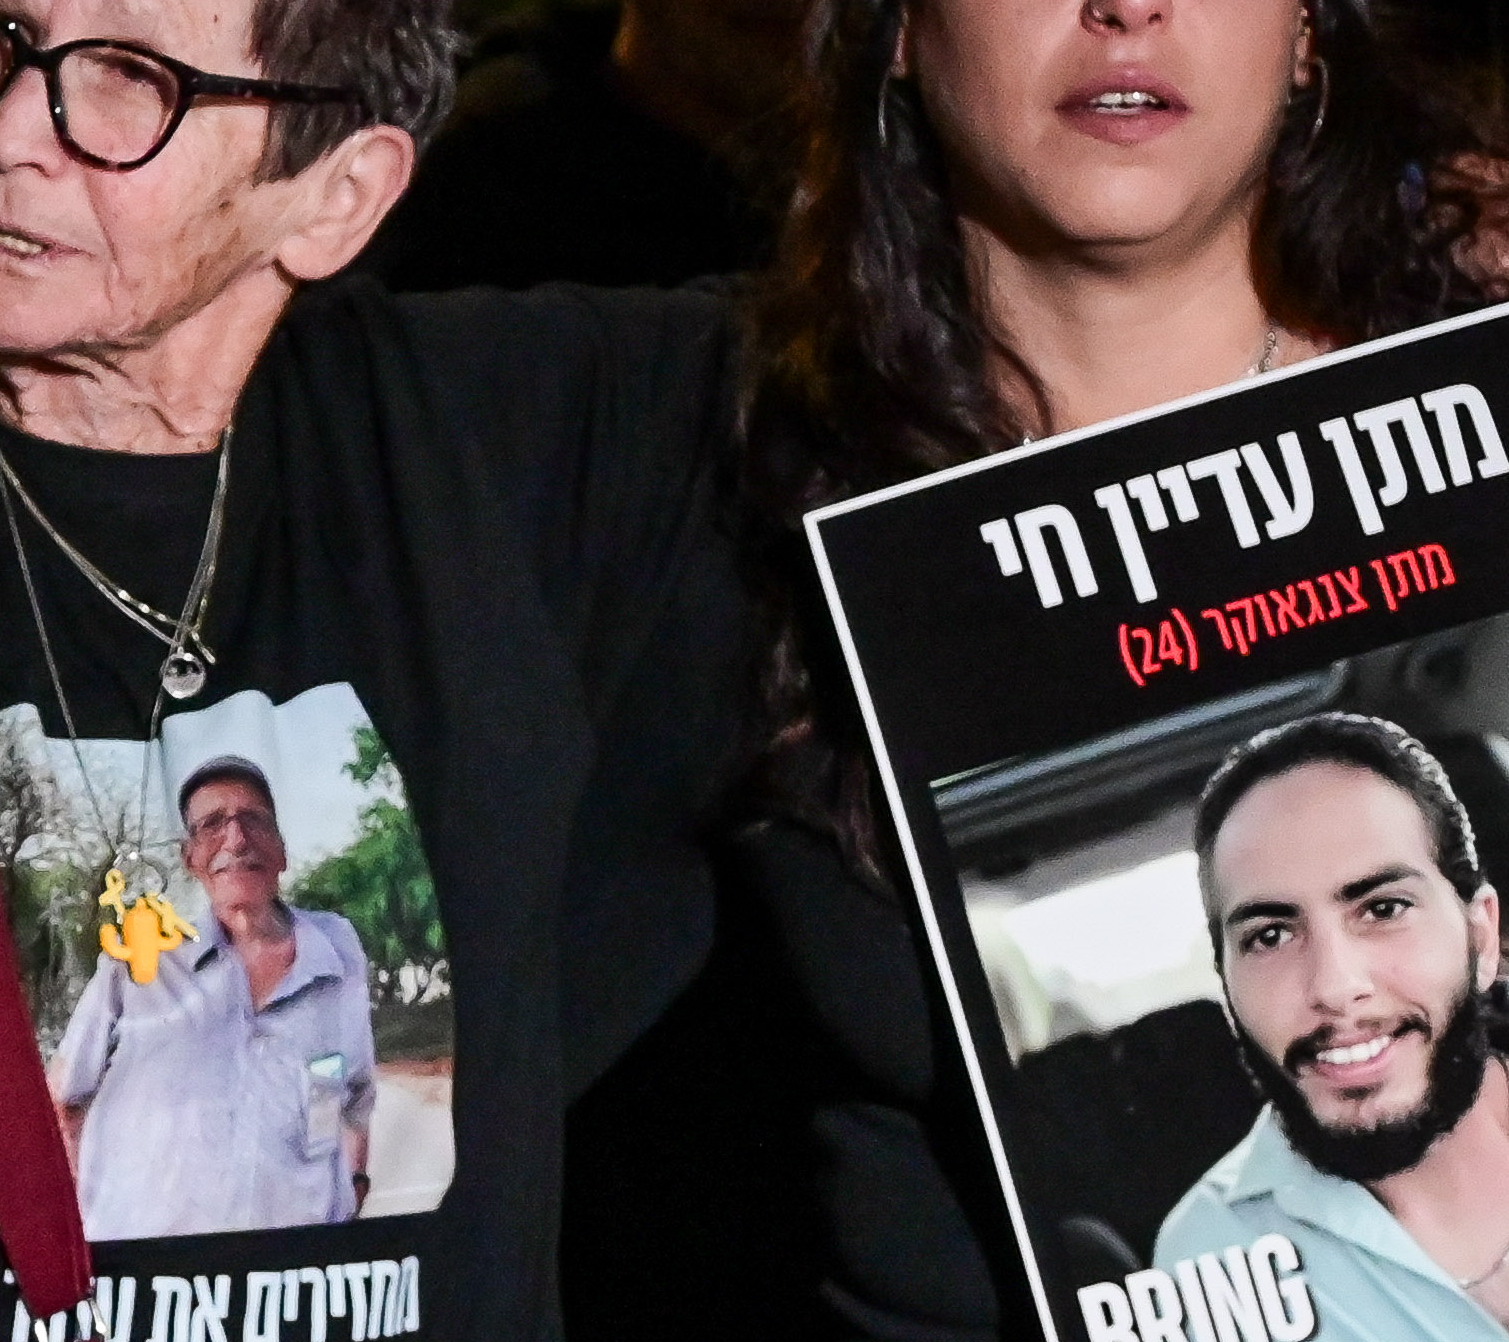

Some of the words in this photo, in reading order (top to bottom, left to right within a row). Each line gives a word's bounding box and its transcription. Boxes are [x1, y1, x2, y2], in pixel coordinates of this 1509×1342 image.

[980, 503, 1099, 609] חי
[1094, 431, 1314, 604] עדיין
[1201, 566, 1369, 656] צנגאוקר
[1369, 543, 1457, 613] מתן
[1117, 608, 1199, 687] (24)
